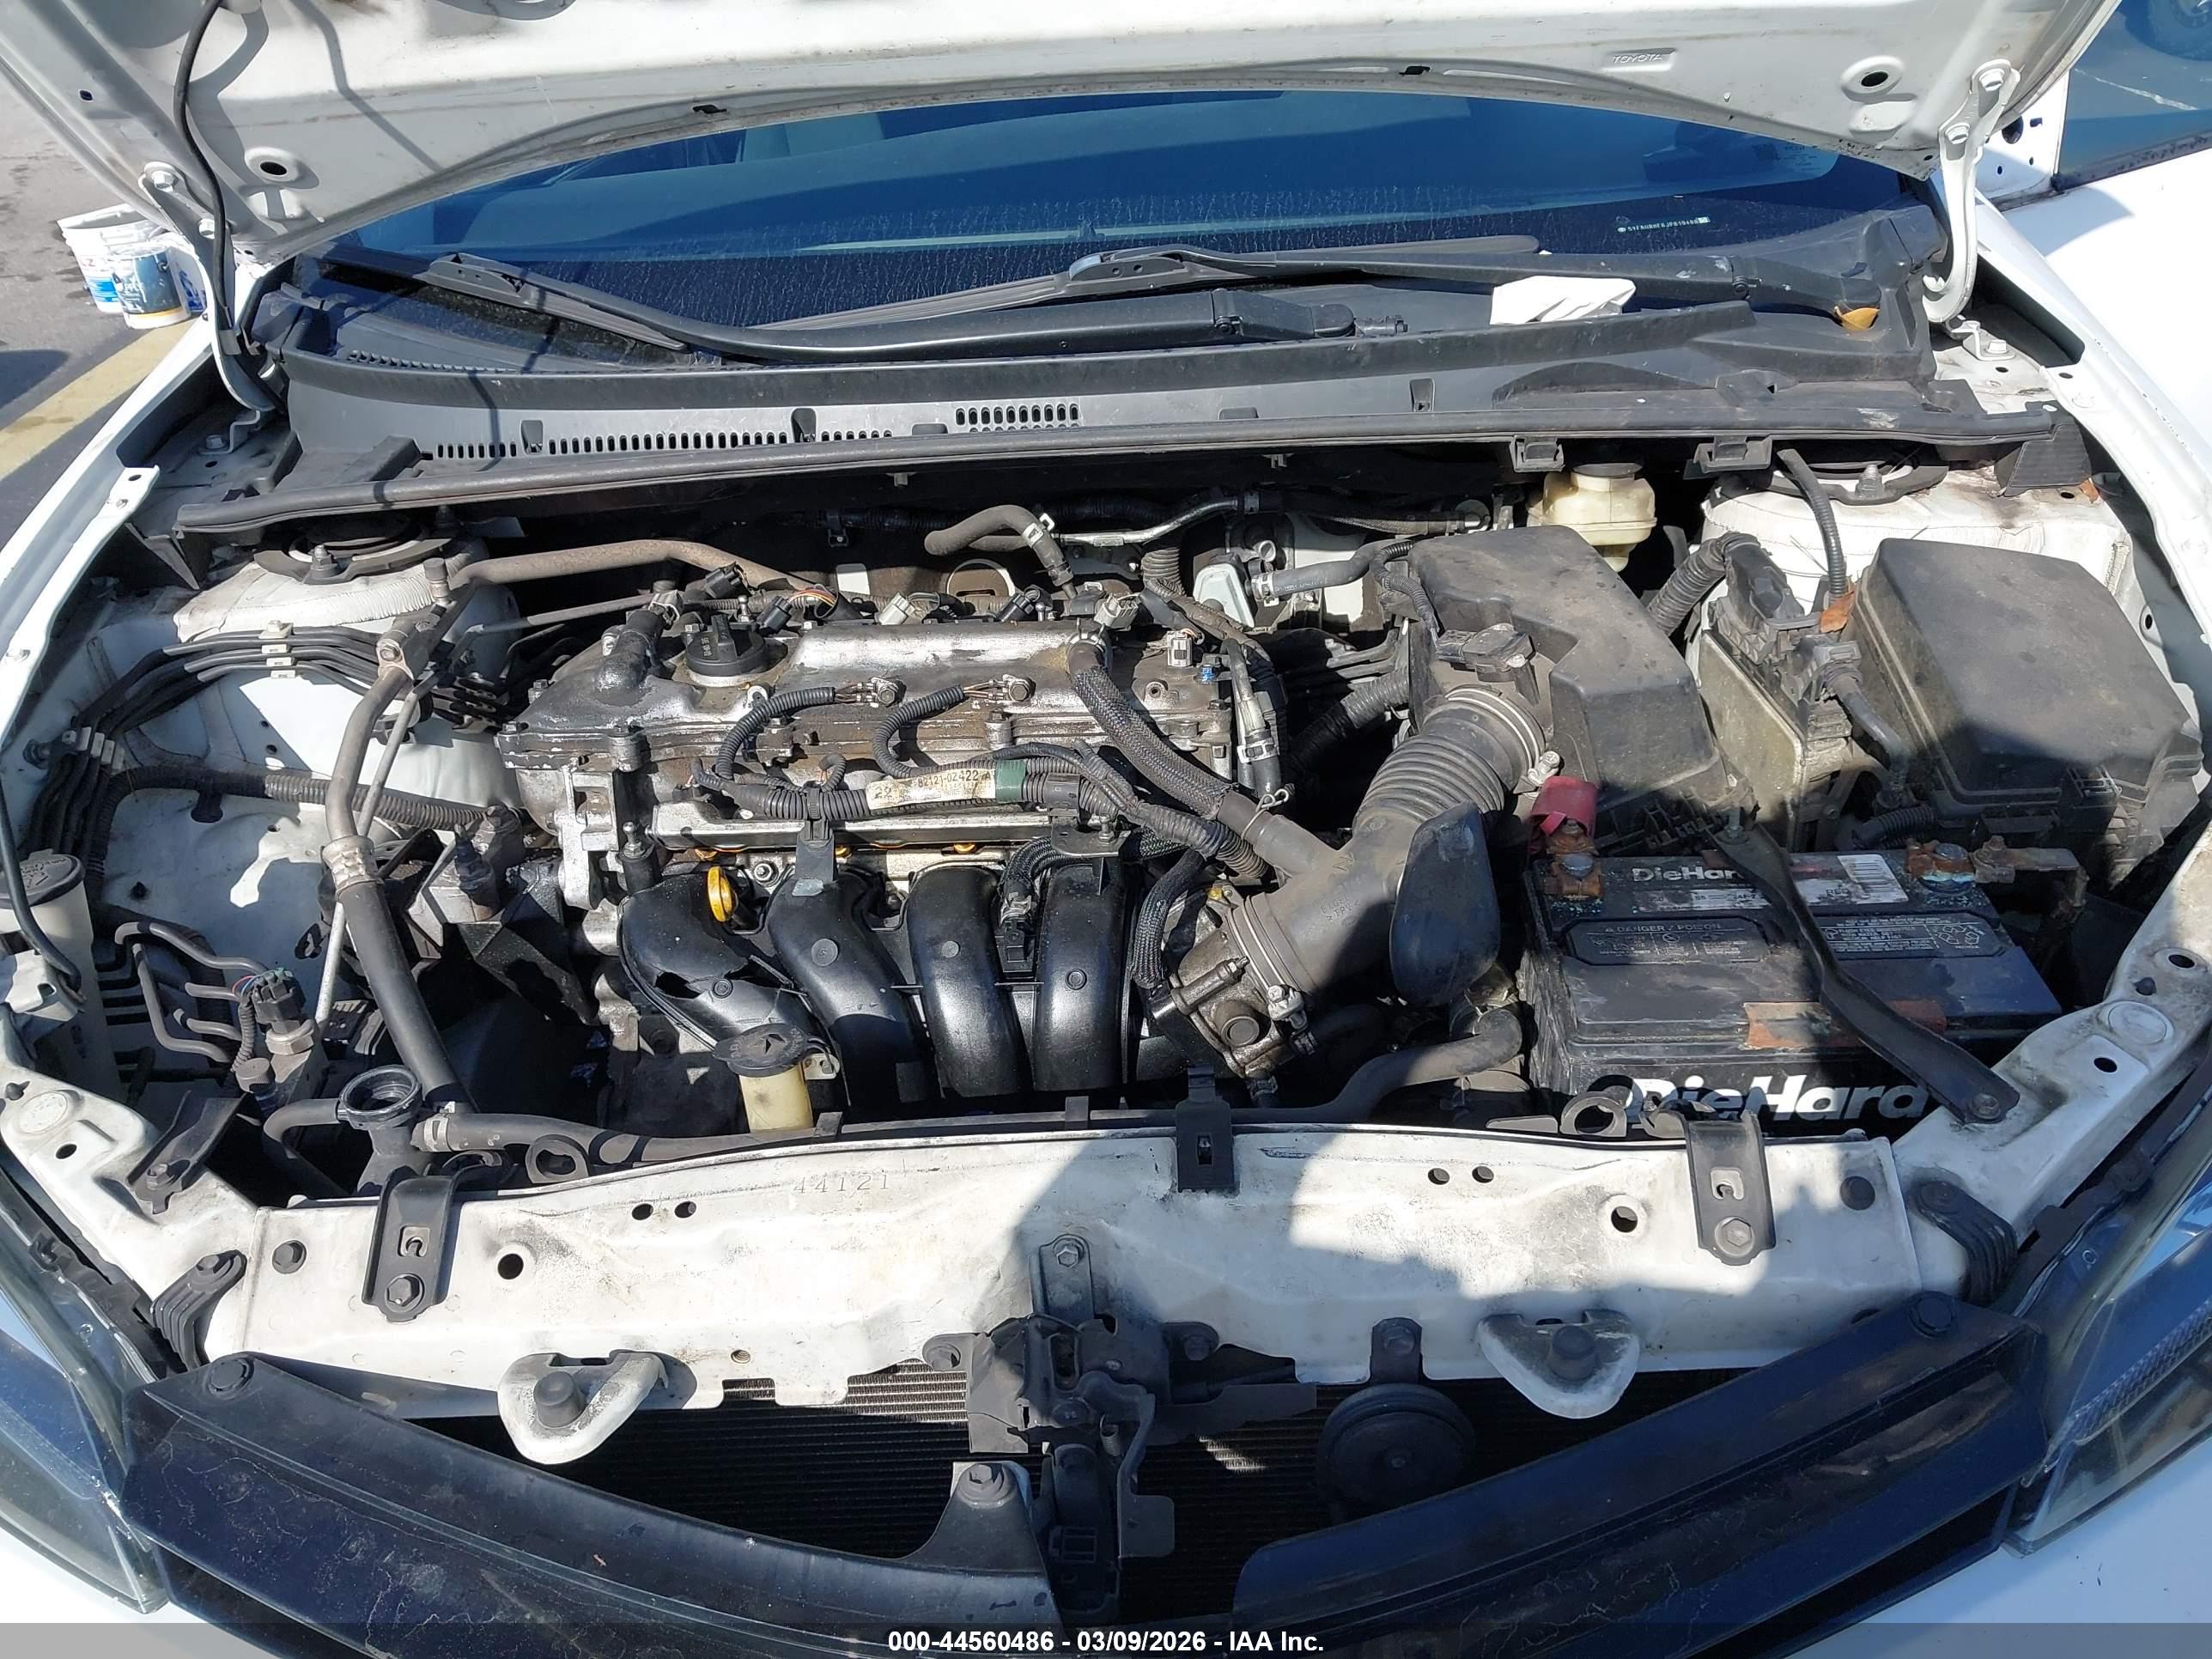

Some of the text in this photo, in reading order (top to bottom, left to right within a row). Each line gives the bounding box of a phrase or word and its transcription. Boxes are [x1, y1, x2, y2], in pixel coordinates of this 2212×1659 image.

[1613, 53, 1663, 64] TOYOTA
[1632, 866, 1744, 882] DieHar
[793, 1174, 890, 1194] 44121
